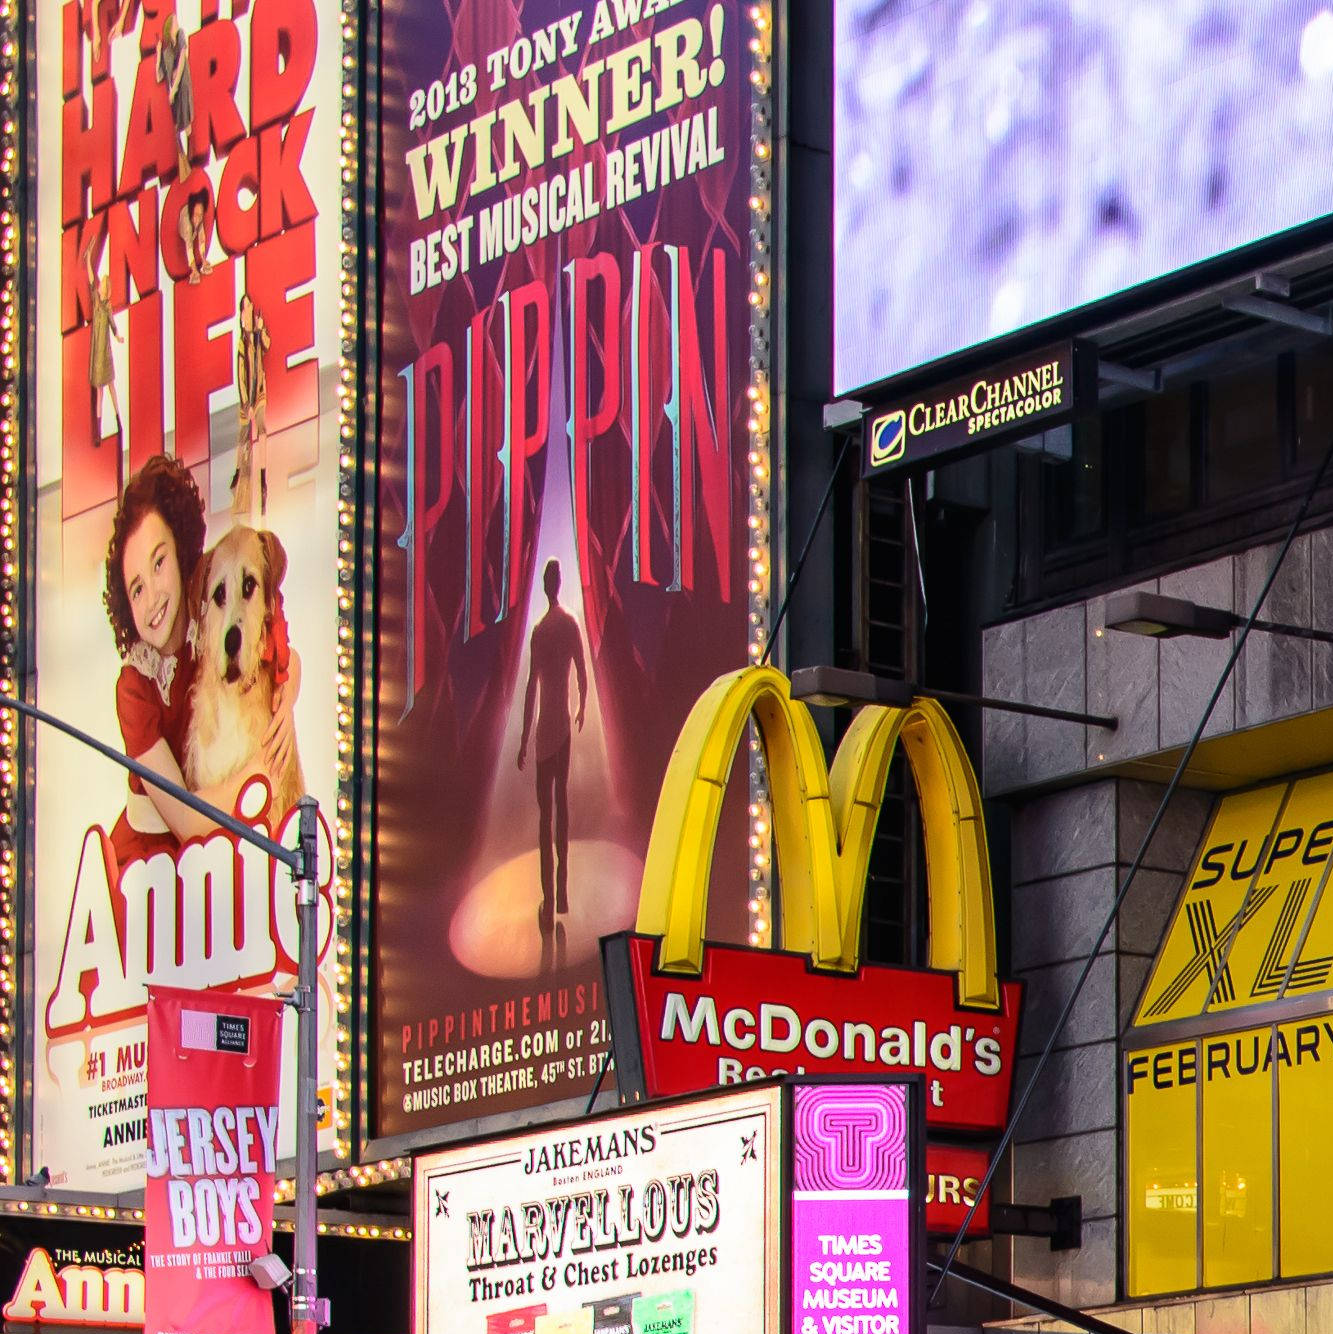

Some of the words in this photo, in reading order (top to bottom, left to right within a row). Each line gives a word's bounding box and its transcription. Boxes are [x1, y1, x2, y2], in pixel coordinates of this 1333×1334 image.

[410, 63, 479, 131] 2013
[487, 10, 583, 91] TONY
[62, 0, 318, 224] HARD
[406, 3, 726, 221] WINNER!
[62, 108, 318, 332] KNOCK
[411, 216, 474, 295] BEST
[479, 162, 600, 265] MUSICAL
[606, 106, 725, 209] REVIVAL
[62, 216, 319, 520] LIFE
[968, 388, 1061, 435] SPECTACOLOR
[396, 242, 732, 725] PIPPIN
[47, 774, 334, 1038] Annie
[222, 1022, 245, 1032] TIMES
[660, 992, 1002, 1078] McDonald's
[87, 1051, 106, 1080] #1
[403, 1029, 559, 1085] TELECHARGE.COM
[565, 1028, 583, 1050] or
[454, 1079, 477, 1104] BOX
[480, 1070, 538, 1098] THEATRE,
[568, 1057, 585, 1080] ST.
[147, 1106, 278, 1178] JERSEY
[524, 1125, 657, 1175] JAKEMANS
[583, 1165, 623, 1182] ENGLAND
[168, 1177, 264, 1248] BOYS
[466, 1168, 721, 1272] MARVELLOUS
[55, 1249, 79, 1264] THE
[85, 1250, 142, 1267] MUSICAL
[151, 1254, 165, 1267] THE
[167, 1253, 191, 1266] STORY
[809, 1261, 891, 1284] SQUARE
[818, 1234, 883, 1256] TIMES
[469, 1268, 534, 1302] Throat
[541, 1266, 558, 1291] &
[564, 1258, 619, 1287] Chest
[626, 1246, 719, 1279] Lozenges
[803, 1289, 899, 1310] MUSEUM
